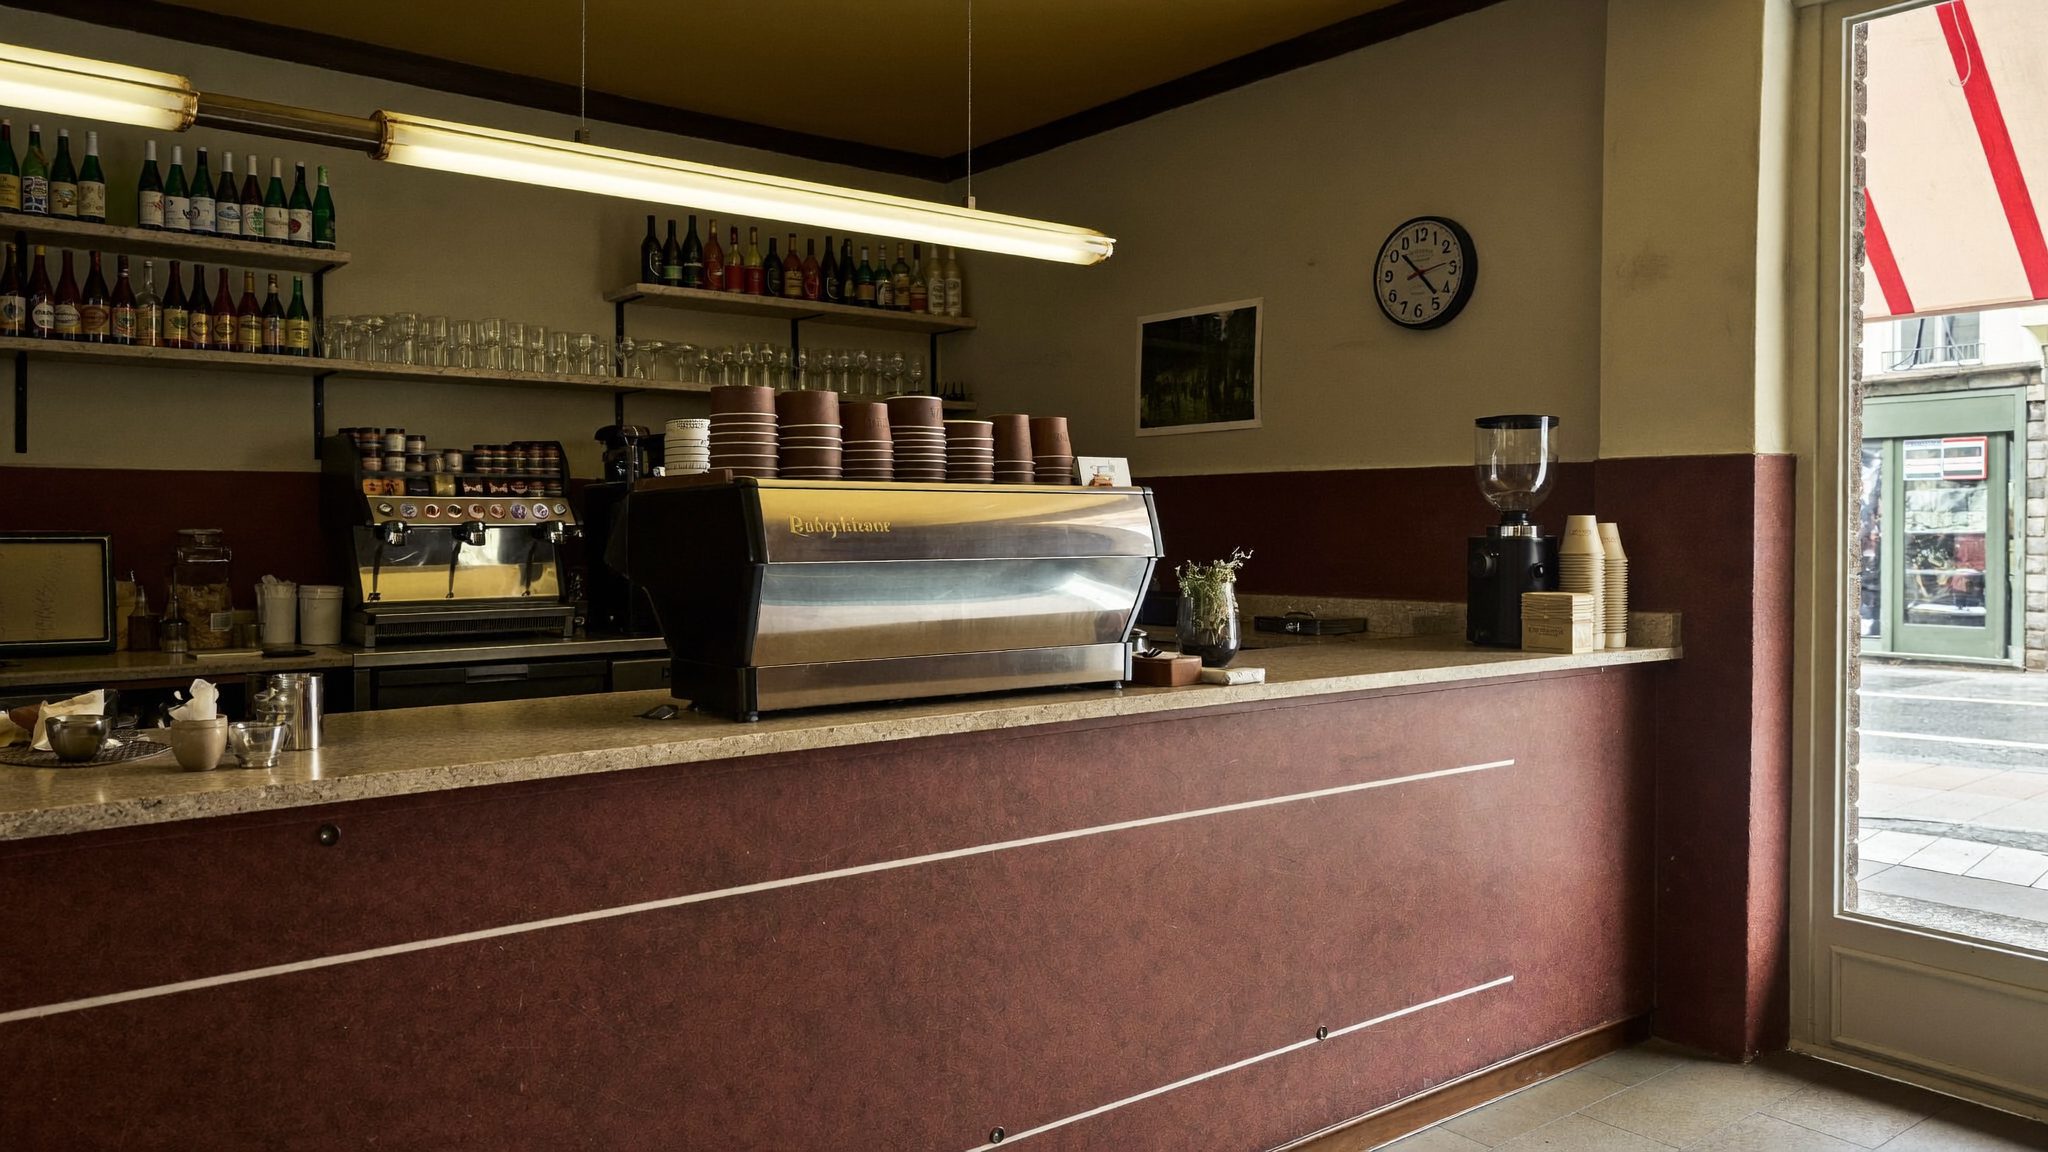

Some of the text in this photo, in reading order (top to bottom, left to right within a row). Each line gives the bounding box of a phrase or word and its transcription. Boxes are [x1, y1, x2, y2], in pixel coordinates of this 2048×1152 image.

[1442, 240, 1450, 253] 2
[1441, 280, 1450, 293] 4
[1400, 301, 1408, 314] 7
[1431, 297, 1440, 310] 5
[1414, 304, 1422, 318] 6
